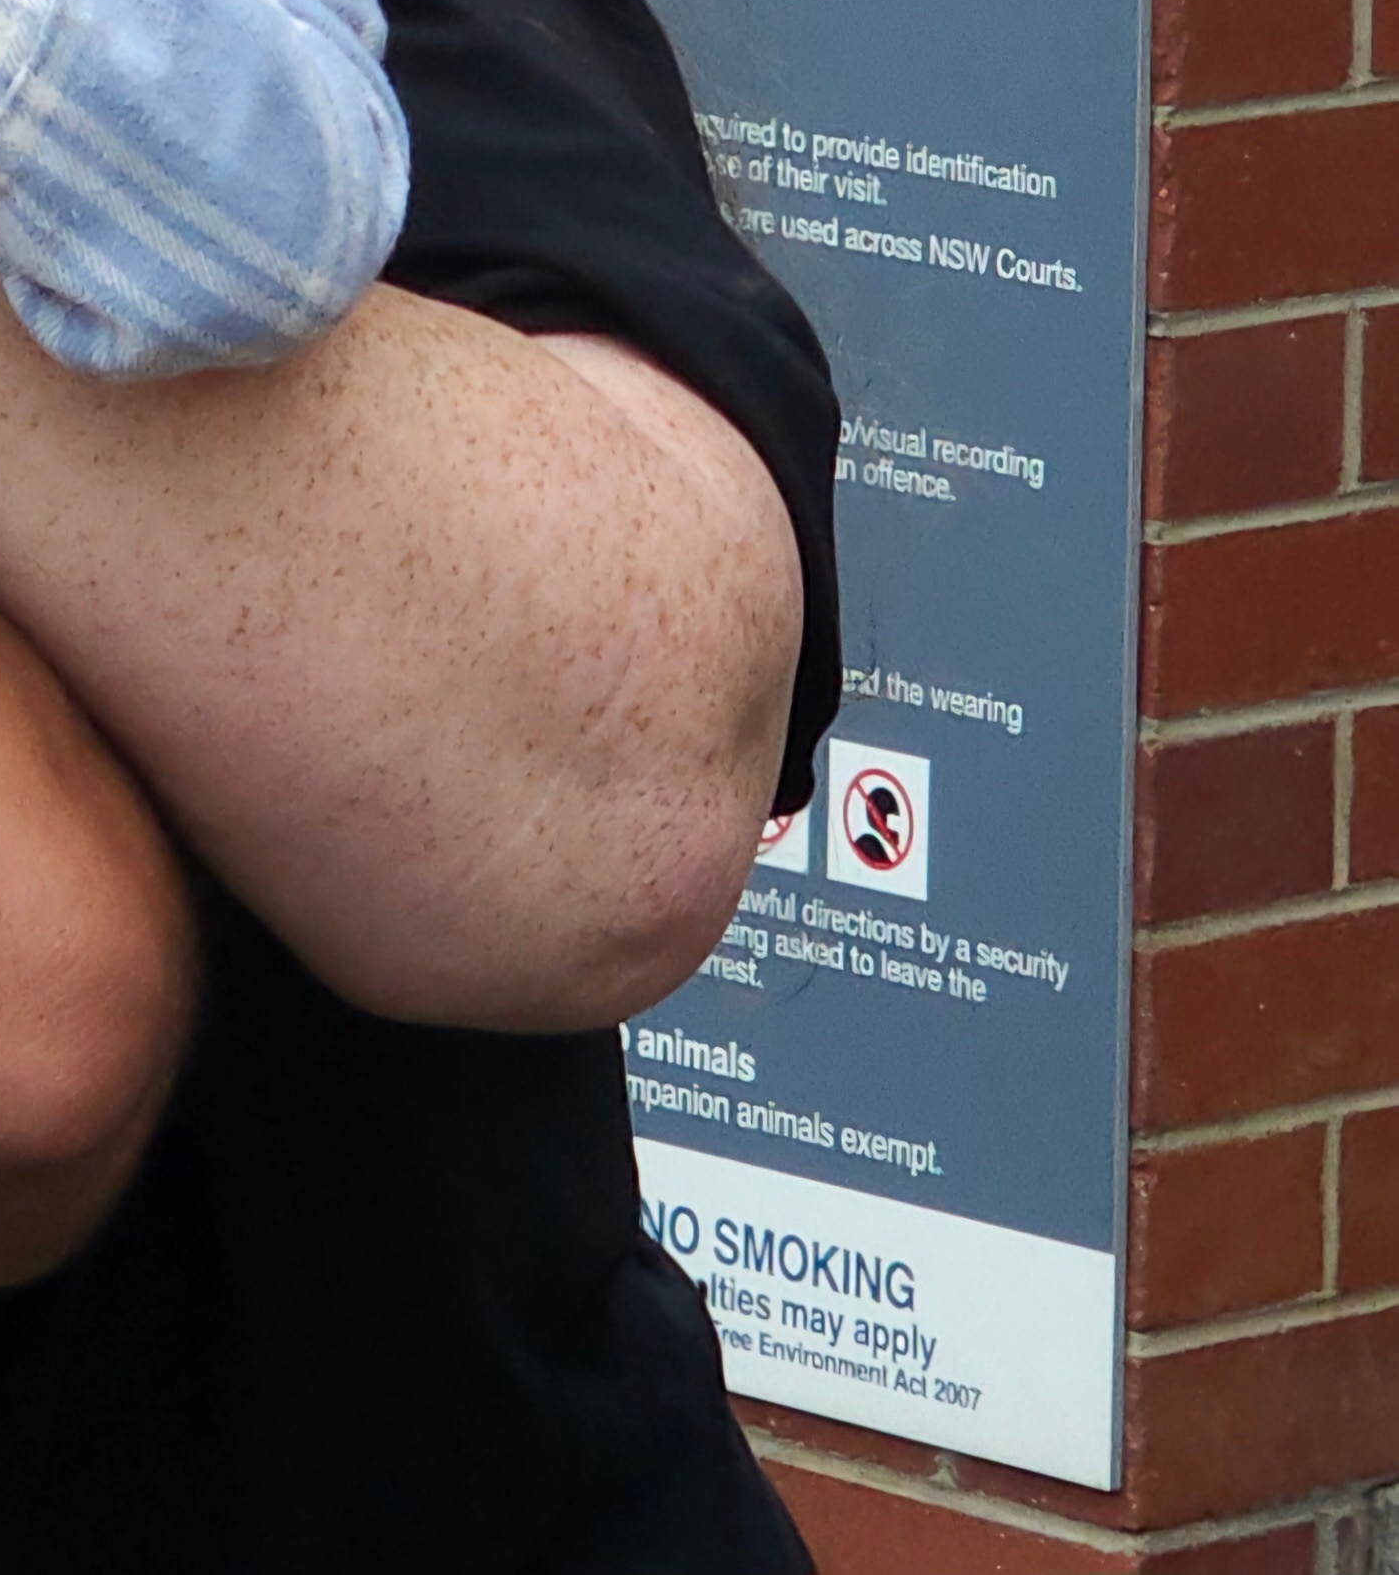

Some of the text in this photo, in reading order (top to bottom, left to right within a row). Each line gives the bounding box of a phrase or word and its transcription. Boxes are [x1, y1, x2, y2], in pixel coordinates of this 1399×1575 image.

[694, 112, 1056, 198] quired to provide identification
[749, 156, 772, 182] of
[777, 159, 829, 193] their
[834, 171, 887, 204] visit.
[782, 216, 838, 246] used
[845, 228, 922, 261] across
[930, 235, 990, 274] NSW
[997, 249, 1082, 291] Courts.
[839, 417, 1044, 489] o/visual recording
[864, 458, 956, 500] offence.
[887, 673, 923, 705] the
[931, 687, 1022, 734] wearing
[699, 954, 764, 988] rrest.
[736, 888, 795, 922] awful
[802, 899, 914, 949] directions
[921, 923, 949, 962] by
[977, 943, 1068, 991] security
[775, 933, 843, 970] asked
[850, 946, 873, 975] to
[881, 950, 943, 991] leave
[948, 968, 986, 1001] the
[638, 1029, 755, 1081] animals
[627, 1074, 941, 1176] mpanion animals exempt.
[639, 1195, 914, 1312] NO SMOKING
[709, 1273, 936, 1371] lties may apply
[714, 1321, 981, 1410] ree Environment Act 2007
